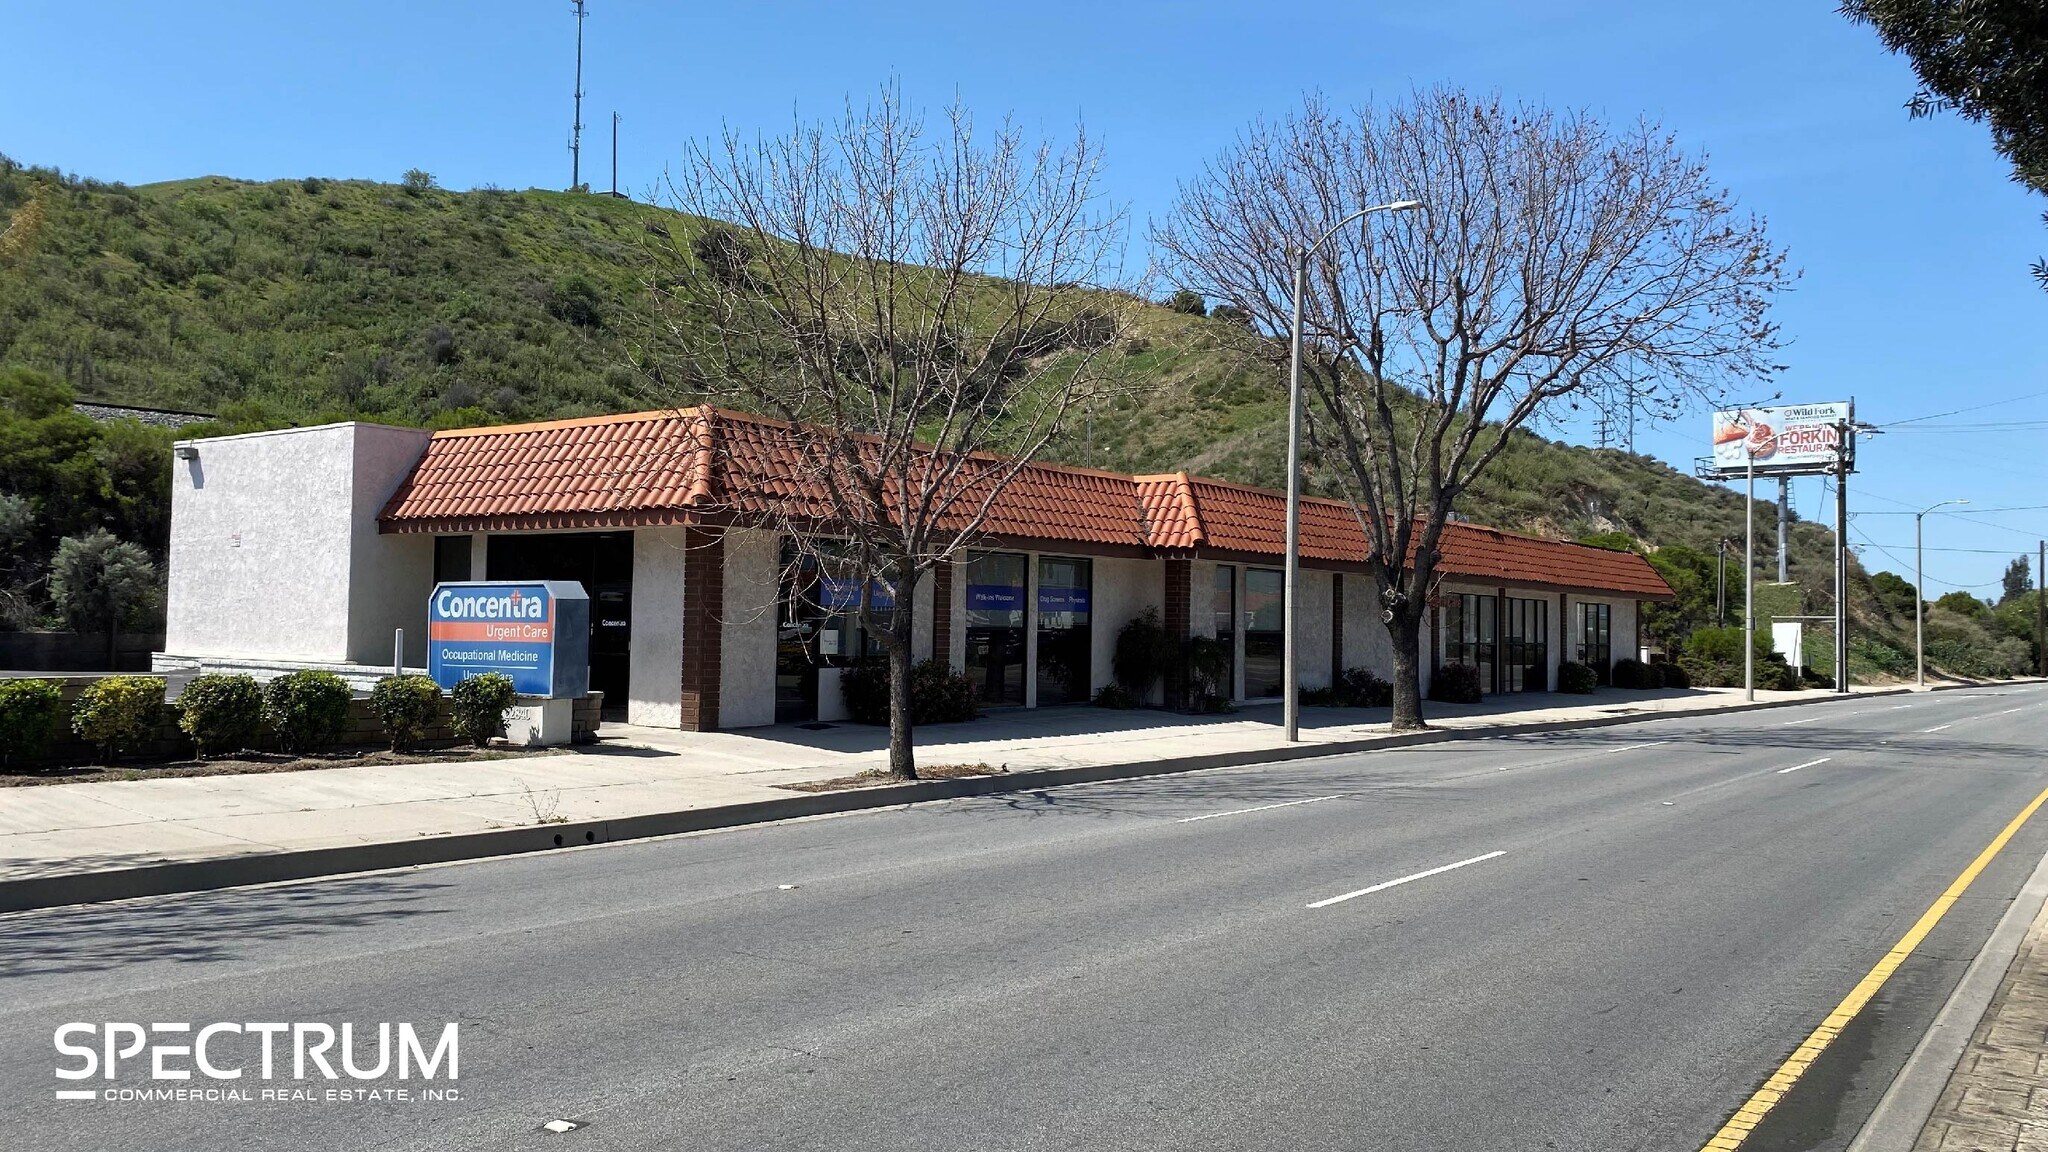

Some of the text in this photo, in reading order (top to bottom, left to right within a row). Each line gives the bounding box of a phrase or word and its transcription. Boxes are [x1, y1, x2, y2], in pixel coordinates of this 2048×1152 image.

[1793, 406, 1836, 416] Wild Fork
[1778, 443, 1832, 454] RESTAURA
[437, 589, 542, 618] Concentra
[486, 624, 548, 640] Urgent Care
[442, 648, 539, 662] Occupational Medicine
